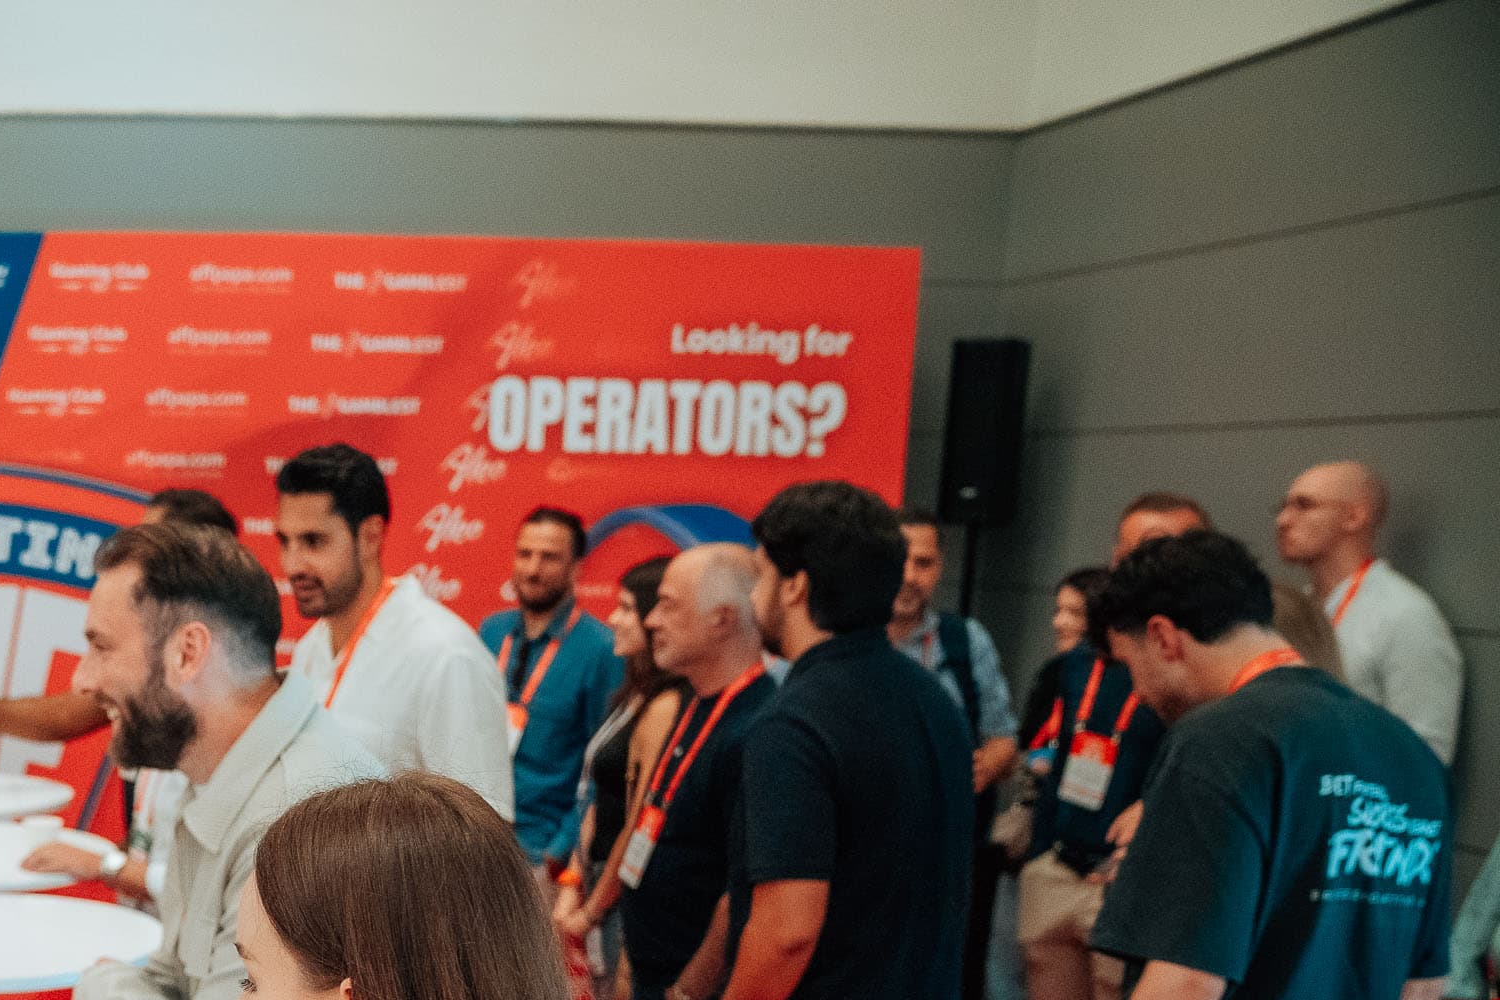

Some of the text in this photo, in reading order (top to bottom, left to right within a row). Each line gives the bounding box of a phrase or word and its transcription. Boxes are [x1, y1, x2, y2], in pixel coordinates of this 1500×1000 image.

[671, 323, 853, 364] Looking for
[488, 375, 847, 458] OPERATORS?
